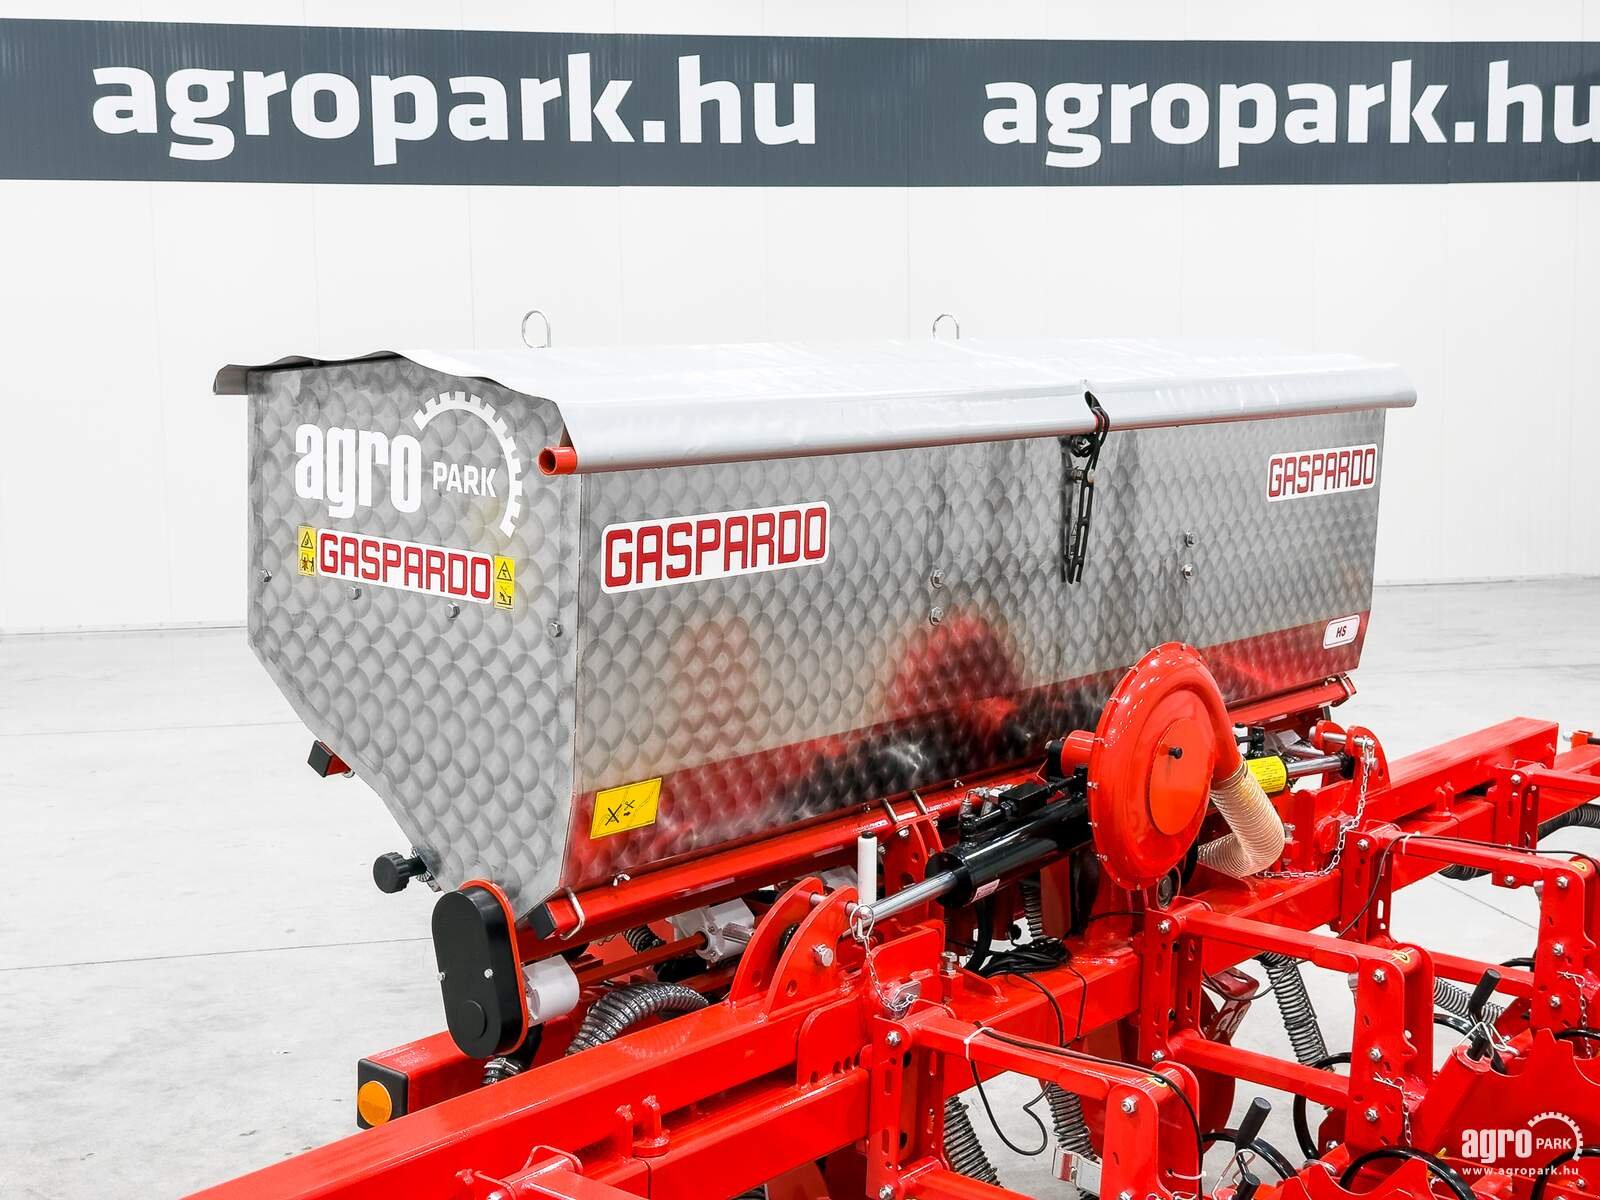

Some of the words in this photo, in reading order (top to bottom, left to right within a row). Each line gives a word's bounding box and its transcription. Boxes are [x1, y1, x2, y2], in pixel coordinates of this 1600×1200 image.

[92, 52, 816, 166] agropark.hu
[983, 59, 1600, 168] agropark.hu
[294, 424, 422, 518] agro
[433, 461, 496, 498] PARK
[1269, 449, 1376, 497] GASPARDO
[320, 533, 491, 600] GASPARDO
[605, 507, 826, 588] GASPARDO
[1336, 626, 1346, 638] HS
